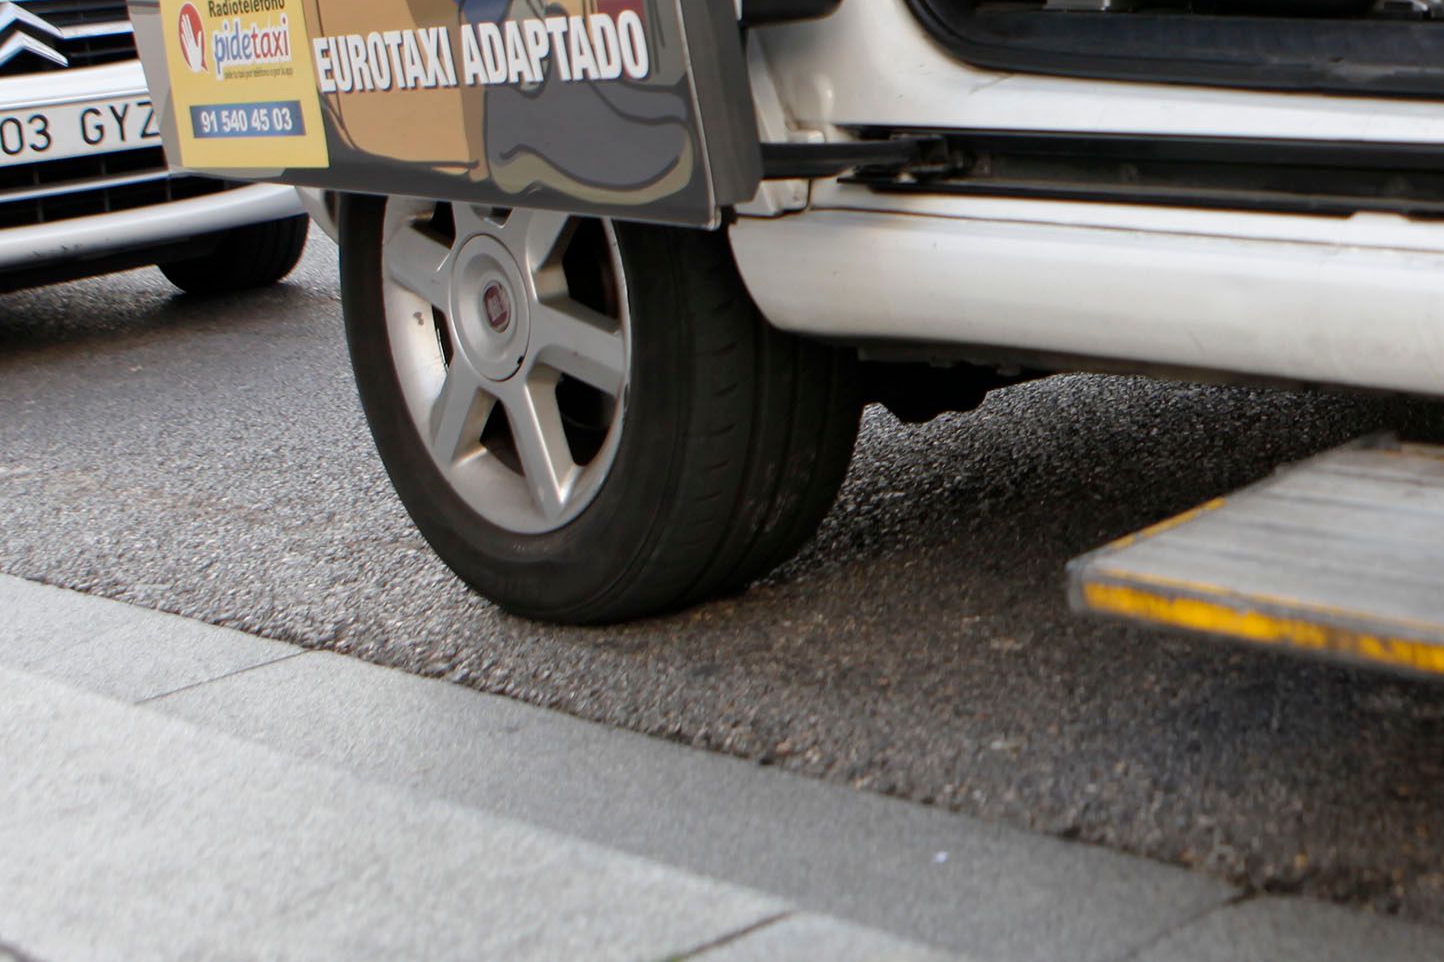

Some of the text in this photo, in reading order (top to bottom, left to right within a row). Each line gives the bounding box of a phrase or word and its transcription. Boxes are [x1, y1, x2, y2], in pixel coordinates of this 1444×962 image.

[214, 16, 290, 76] pidetaxi
[312, 9, 650, 94] EUROTAXI ADAPTADO
[0, 101, 161, 156] 03 GYZ
[200, 106, 293, 134] 91 540 45 03
